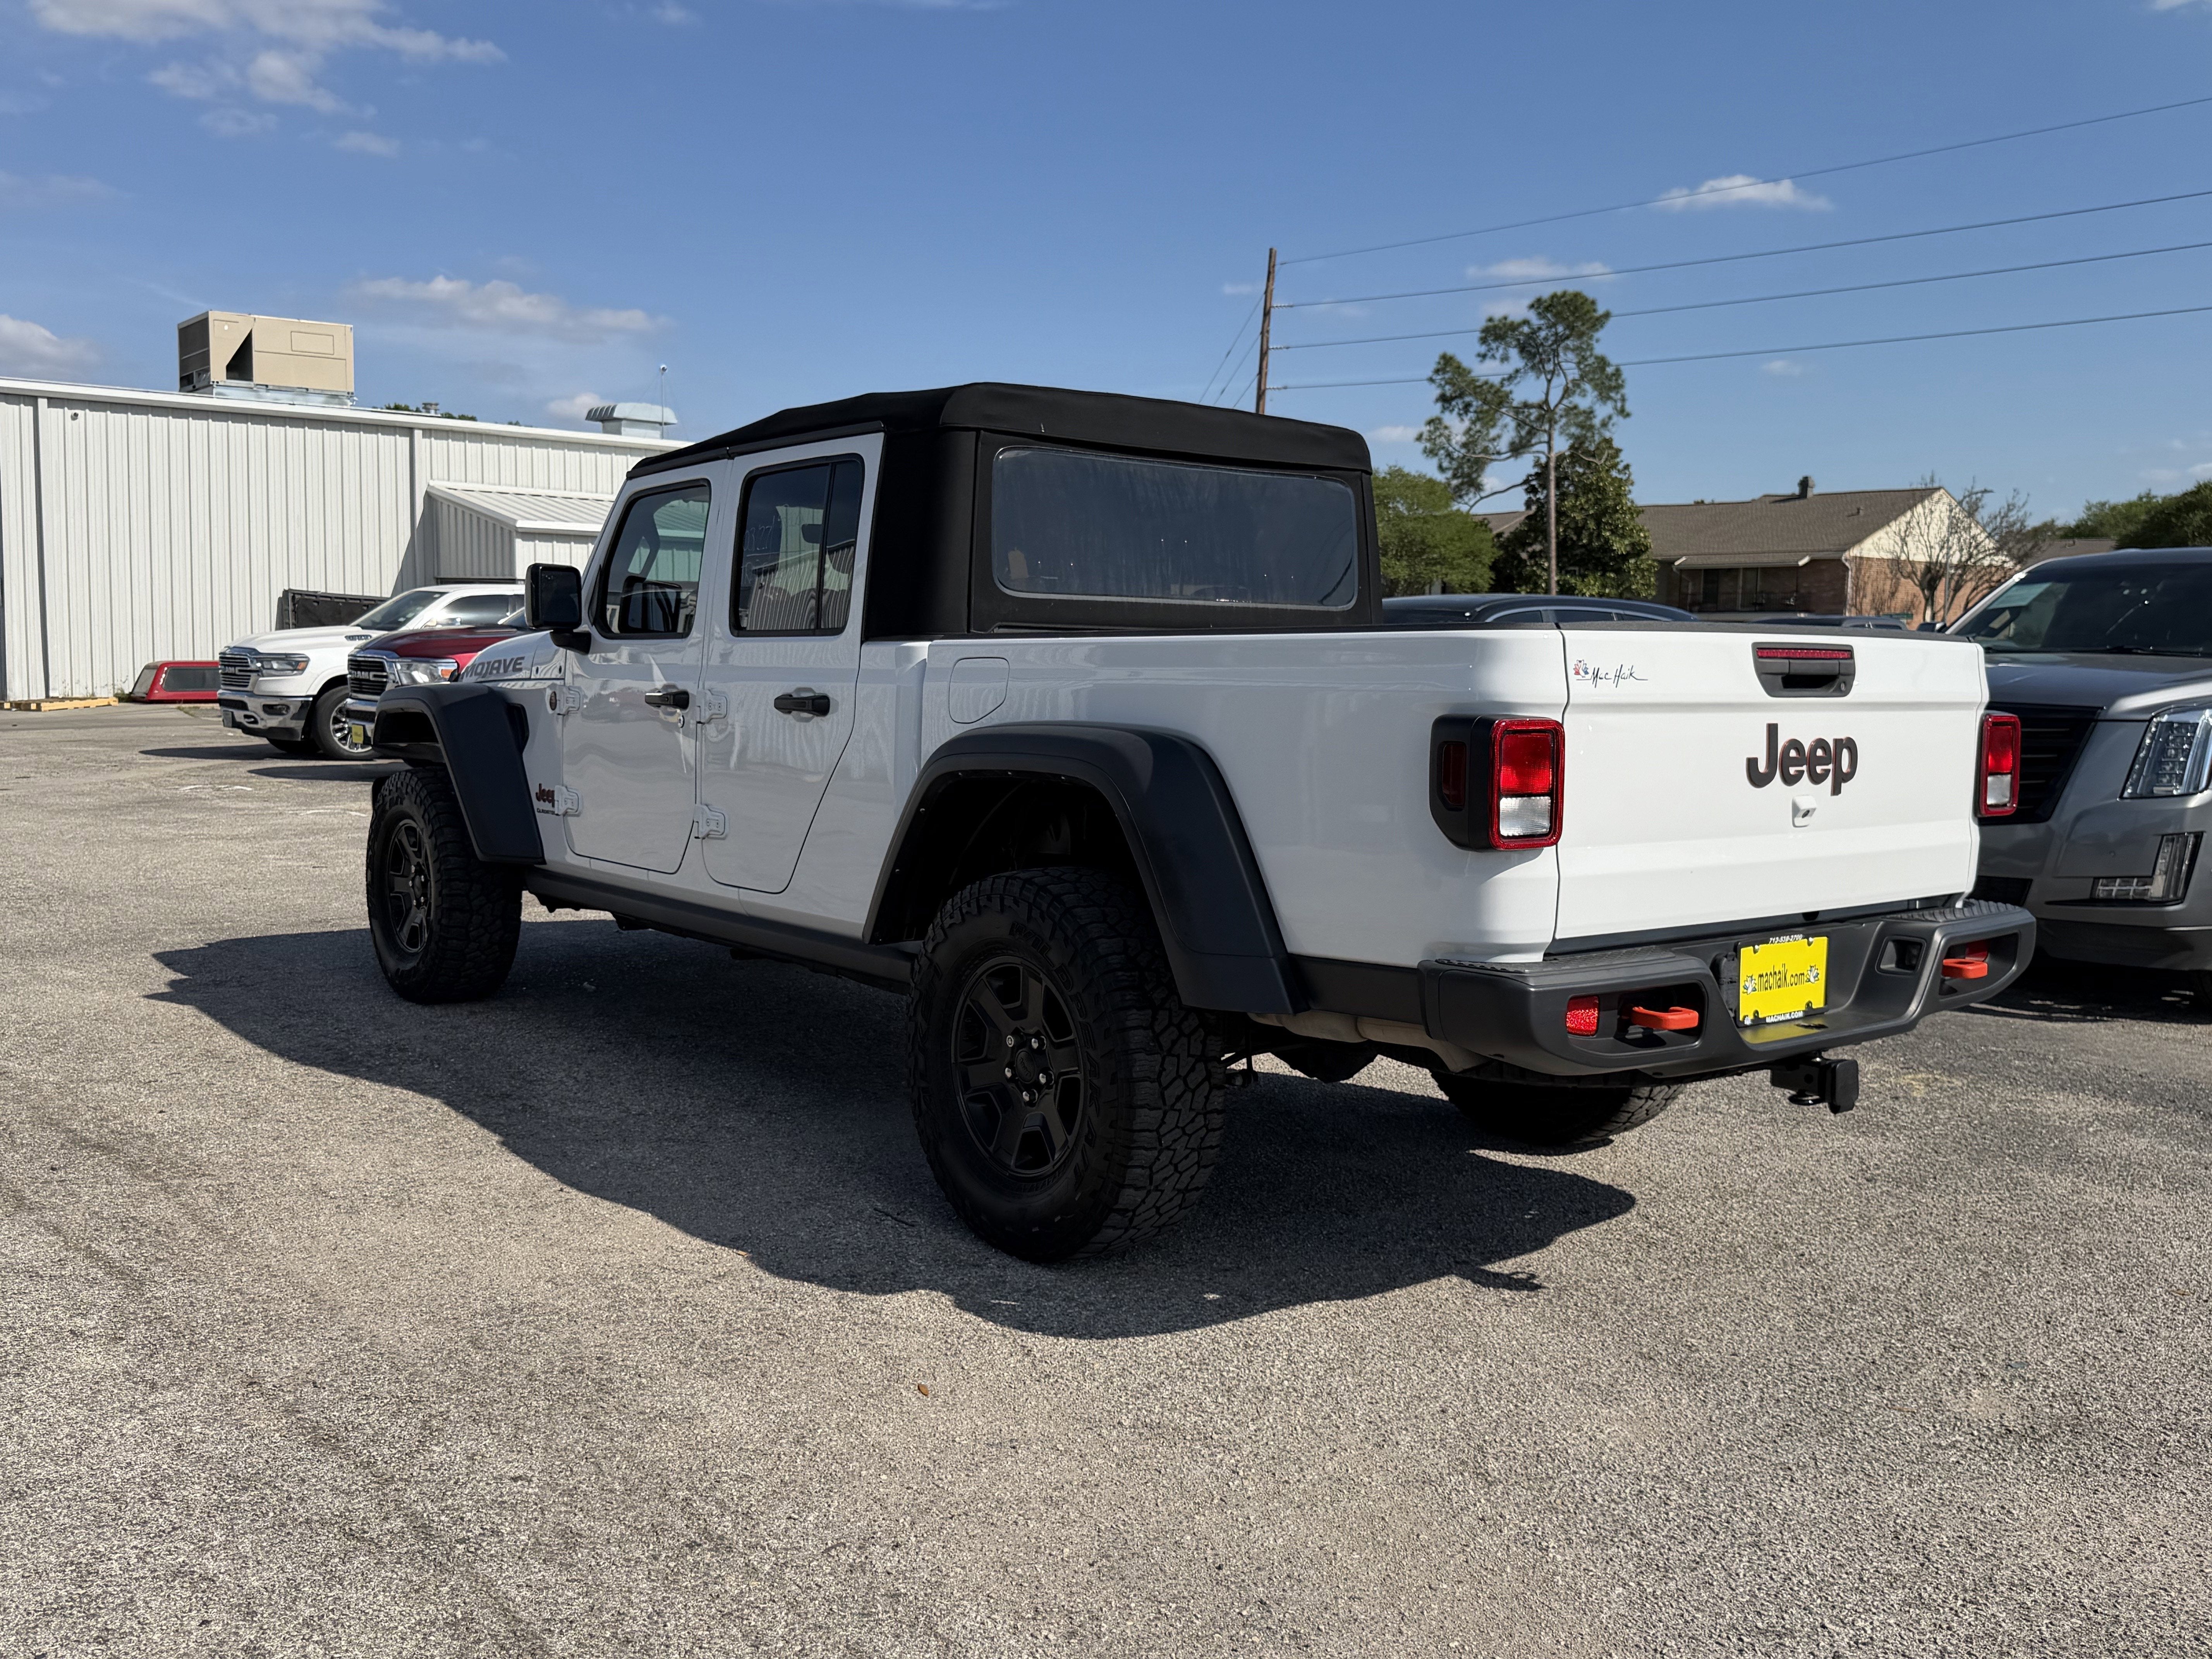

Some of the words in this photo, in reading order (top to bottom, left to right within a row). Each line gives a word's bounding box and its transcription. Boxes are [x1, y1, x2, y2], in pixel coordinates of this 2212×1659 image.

[461, 656, 525, 679] MOJAVE
[1582, 667, 1611, 688] Mac
[1613, 664, 1648, 688] Haik
[1746, 723, 1858, 796] Jeep
[1757, 962, 1805, 992] machaik.com
[1766, 1011, 1803, 1023] MACHAIK.COM
